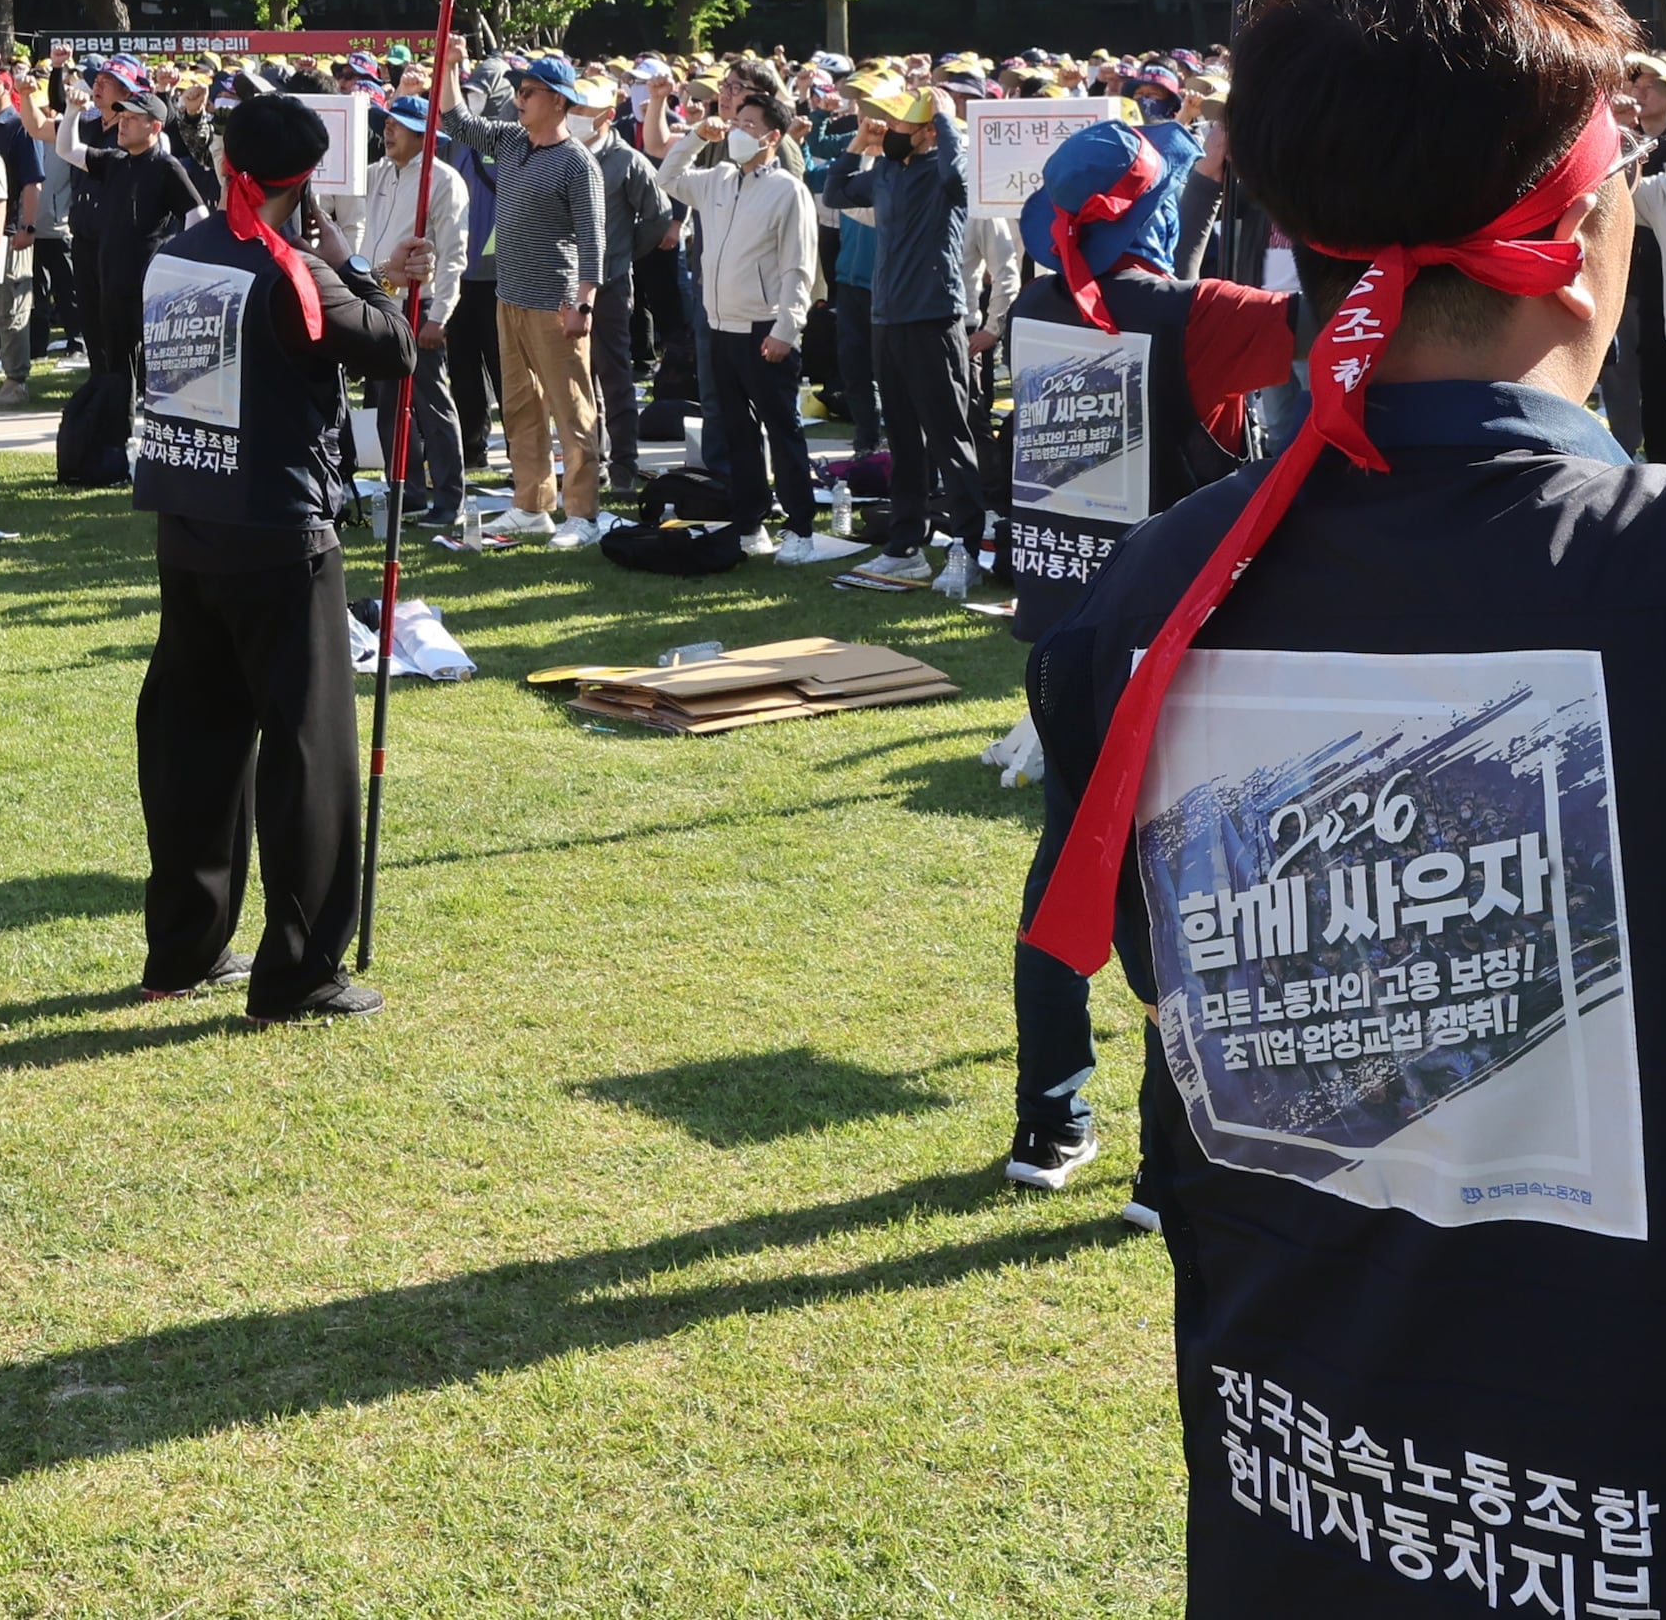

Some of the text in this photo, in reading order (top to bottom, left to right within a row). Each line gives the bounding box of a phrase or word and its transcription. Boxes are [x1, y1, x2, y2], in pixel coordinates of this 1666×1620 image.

[119, 36, 177, 52] 단체교섭
[181, 36, 249, 52] 완전승리!!
[171, 315, 222, 341] 싸우자
[1052, 391, 1123, 428] 싸우자
[1089, 425, 1117, 441] 보장!
[1268, 769, 1418, 882] 2026
[1178, 832, 1550, 973] 함께 싸우자
[1200, 943, 1537, 1030] 모든 노동자의 고용 보장!
[1221, 994, 1520, 1072] 초기업·원청교섭 쟁취!
[1487, 1181, 1593, 1205] 전국금속노동조합
[1211, 1363, 1661, 1558] 전국금속노동조합
[1221, 1428, 1661, 1620] 현대자동차지부
